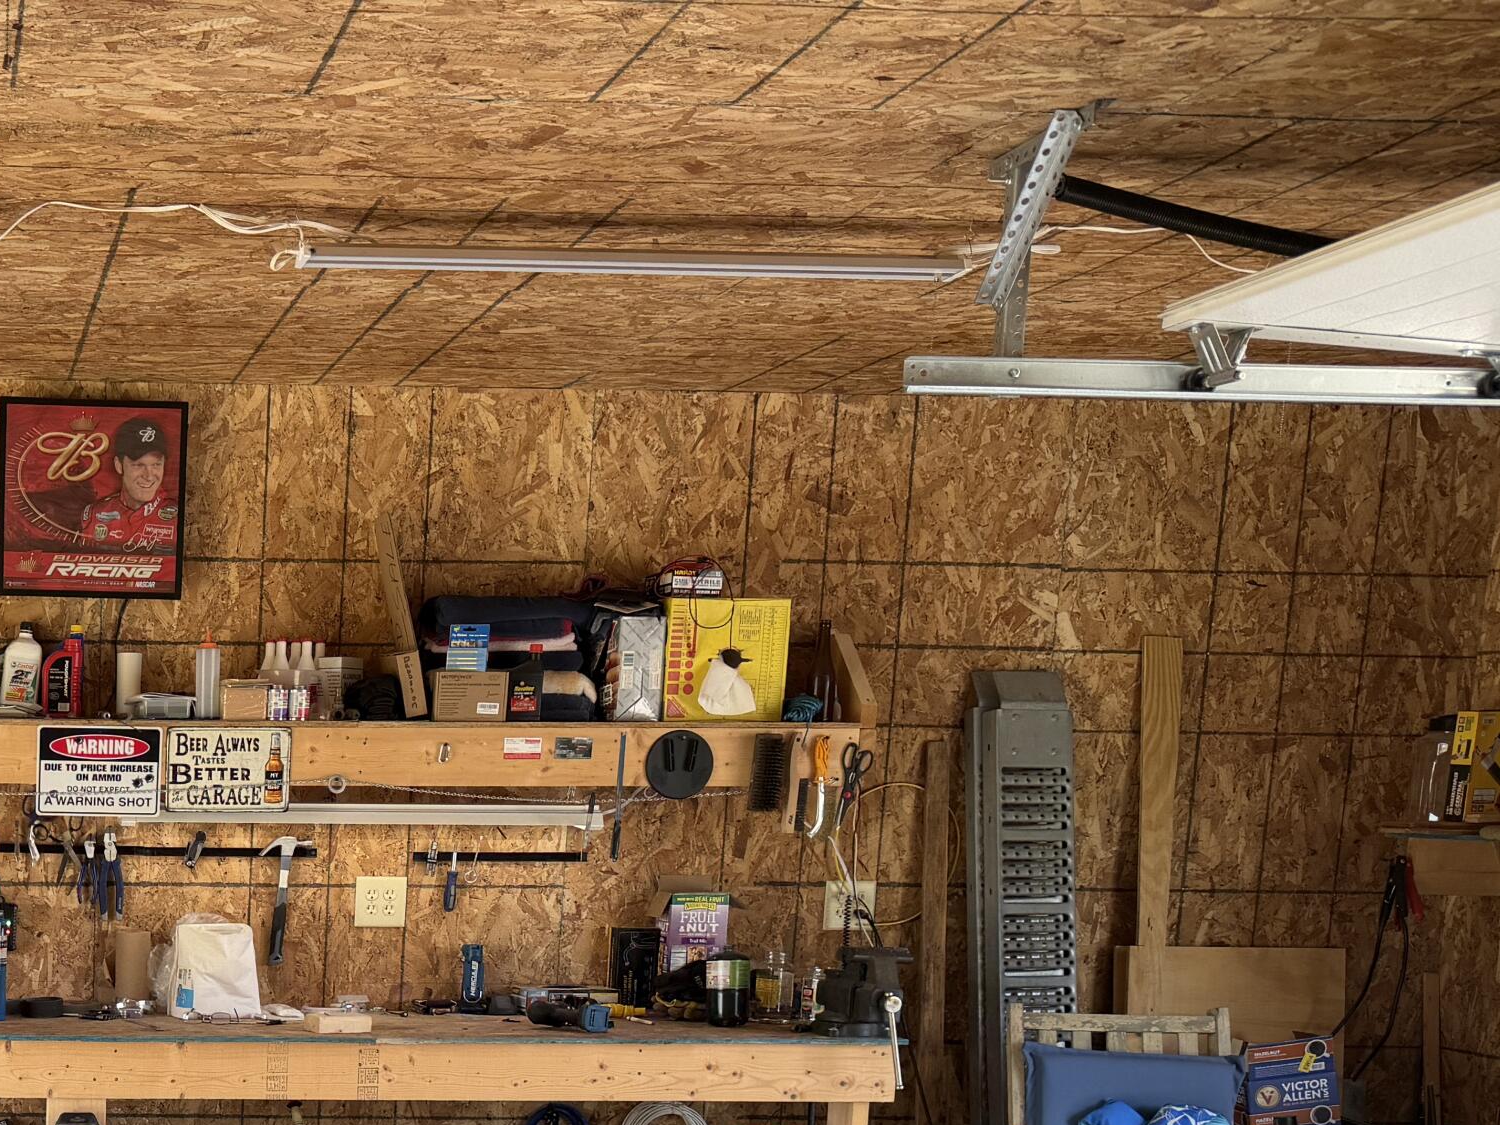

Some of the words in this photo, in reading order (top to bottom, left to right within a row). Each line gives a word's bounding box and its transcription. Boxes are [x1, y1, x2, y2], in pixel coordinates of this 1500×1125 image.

[52, 554, 164, 565] BUDWEISER
[45, 562, 161, 579] RACING
[65, 738, 135, 756] WARNING
[175, 733, 208, 756] BEER
[212, 733, 260, 756] ALWAYS
[192, 755, 226, 765] TASTES
[44, 763, 64, 772] DUE
[66, 763, 79, 772] TO
[81, 763, 109, 773] PRICE
[110, 764, 154, 773] INCREASE
[169, 763, 251, 784] BETTER
[75, 773, 90, 782] ON
[91, 773, 122, 782] AMMO
[66, 785, 79, 793] DO
[81, 785, 98, 793] NOT
[99, 785, 130, 793] EXPECT
[186, 785, 263, 806] GARAGE
[44, 796, 53, 806] A
[55, 796, 115, 807] WARNING
[118, 797, 153, 807] SHOT
[1281, 1078, 1328, 1092] VICTOR
[1282, 1088, 1330, 1103] ALLEN'S
